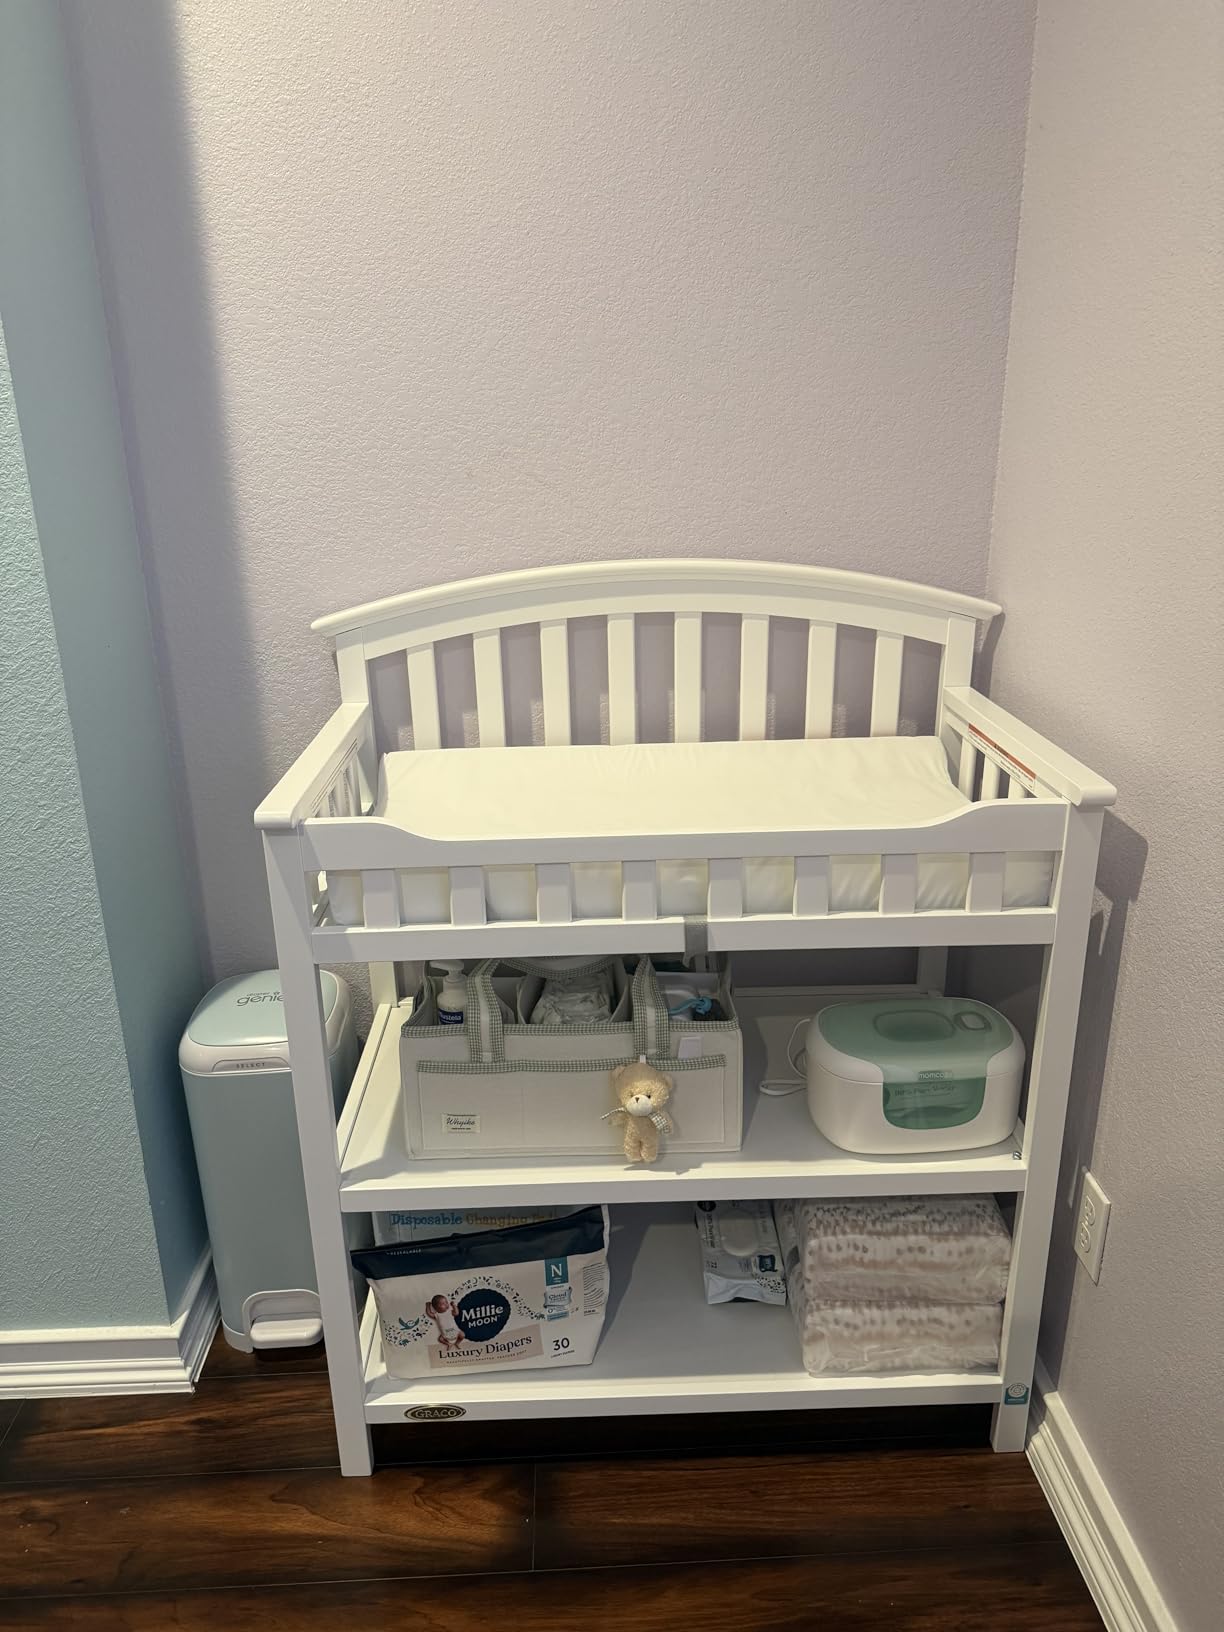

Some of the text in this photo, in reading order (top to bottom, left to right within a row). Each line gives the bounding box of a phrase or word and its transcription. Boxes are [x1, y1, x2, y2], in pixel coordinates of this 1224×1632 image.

[236, 994, 285, 1007] genie
[391, 1213, 463, 1229] Disposable
[551, 1263, 563, 1277] N
[461, 1304, 504, 1322] Millie
[468, 1317, 498, 1329] MOON
[438, 1335, 532, 1359] Luxury Diapers
[552, 1337, 570, 1351] 30
[415, 1409, 457, 1418] GRACO
